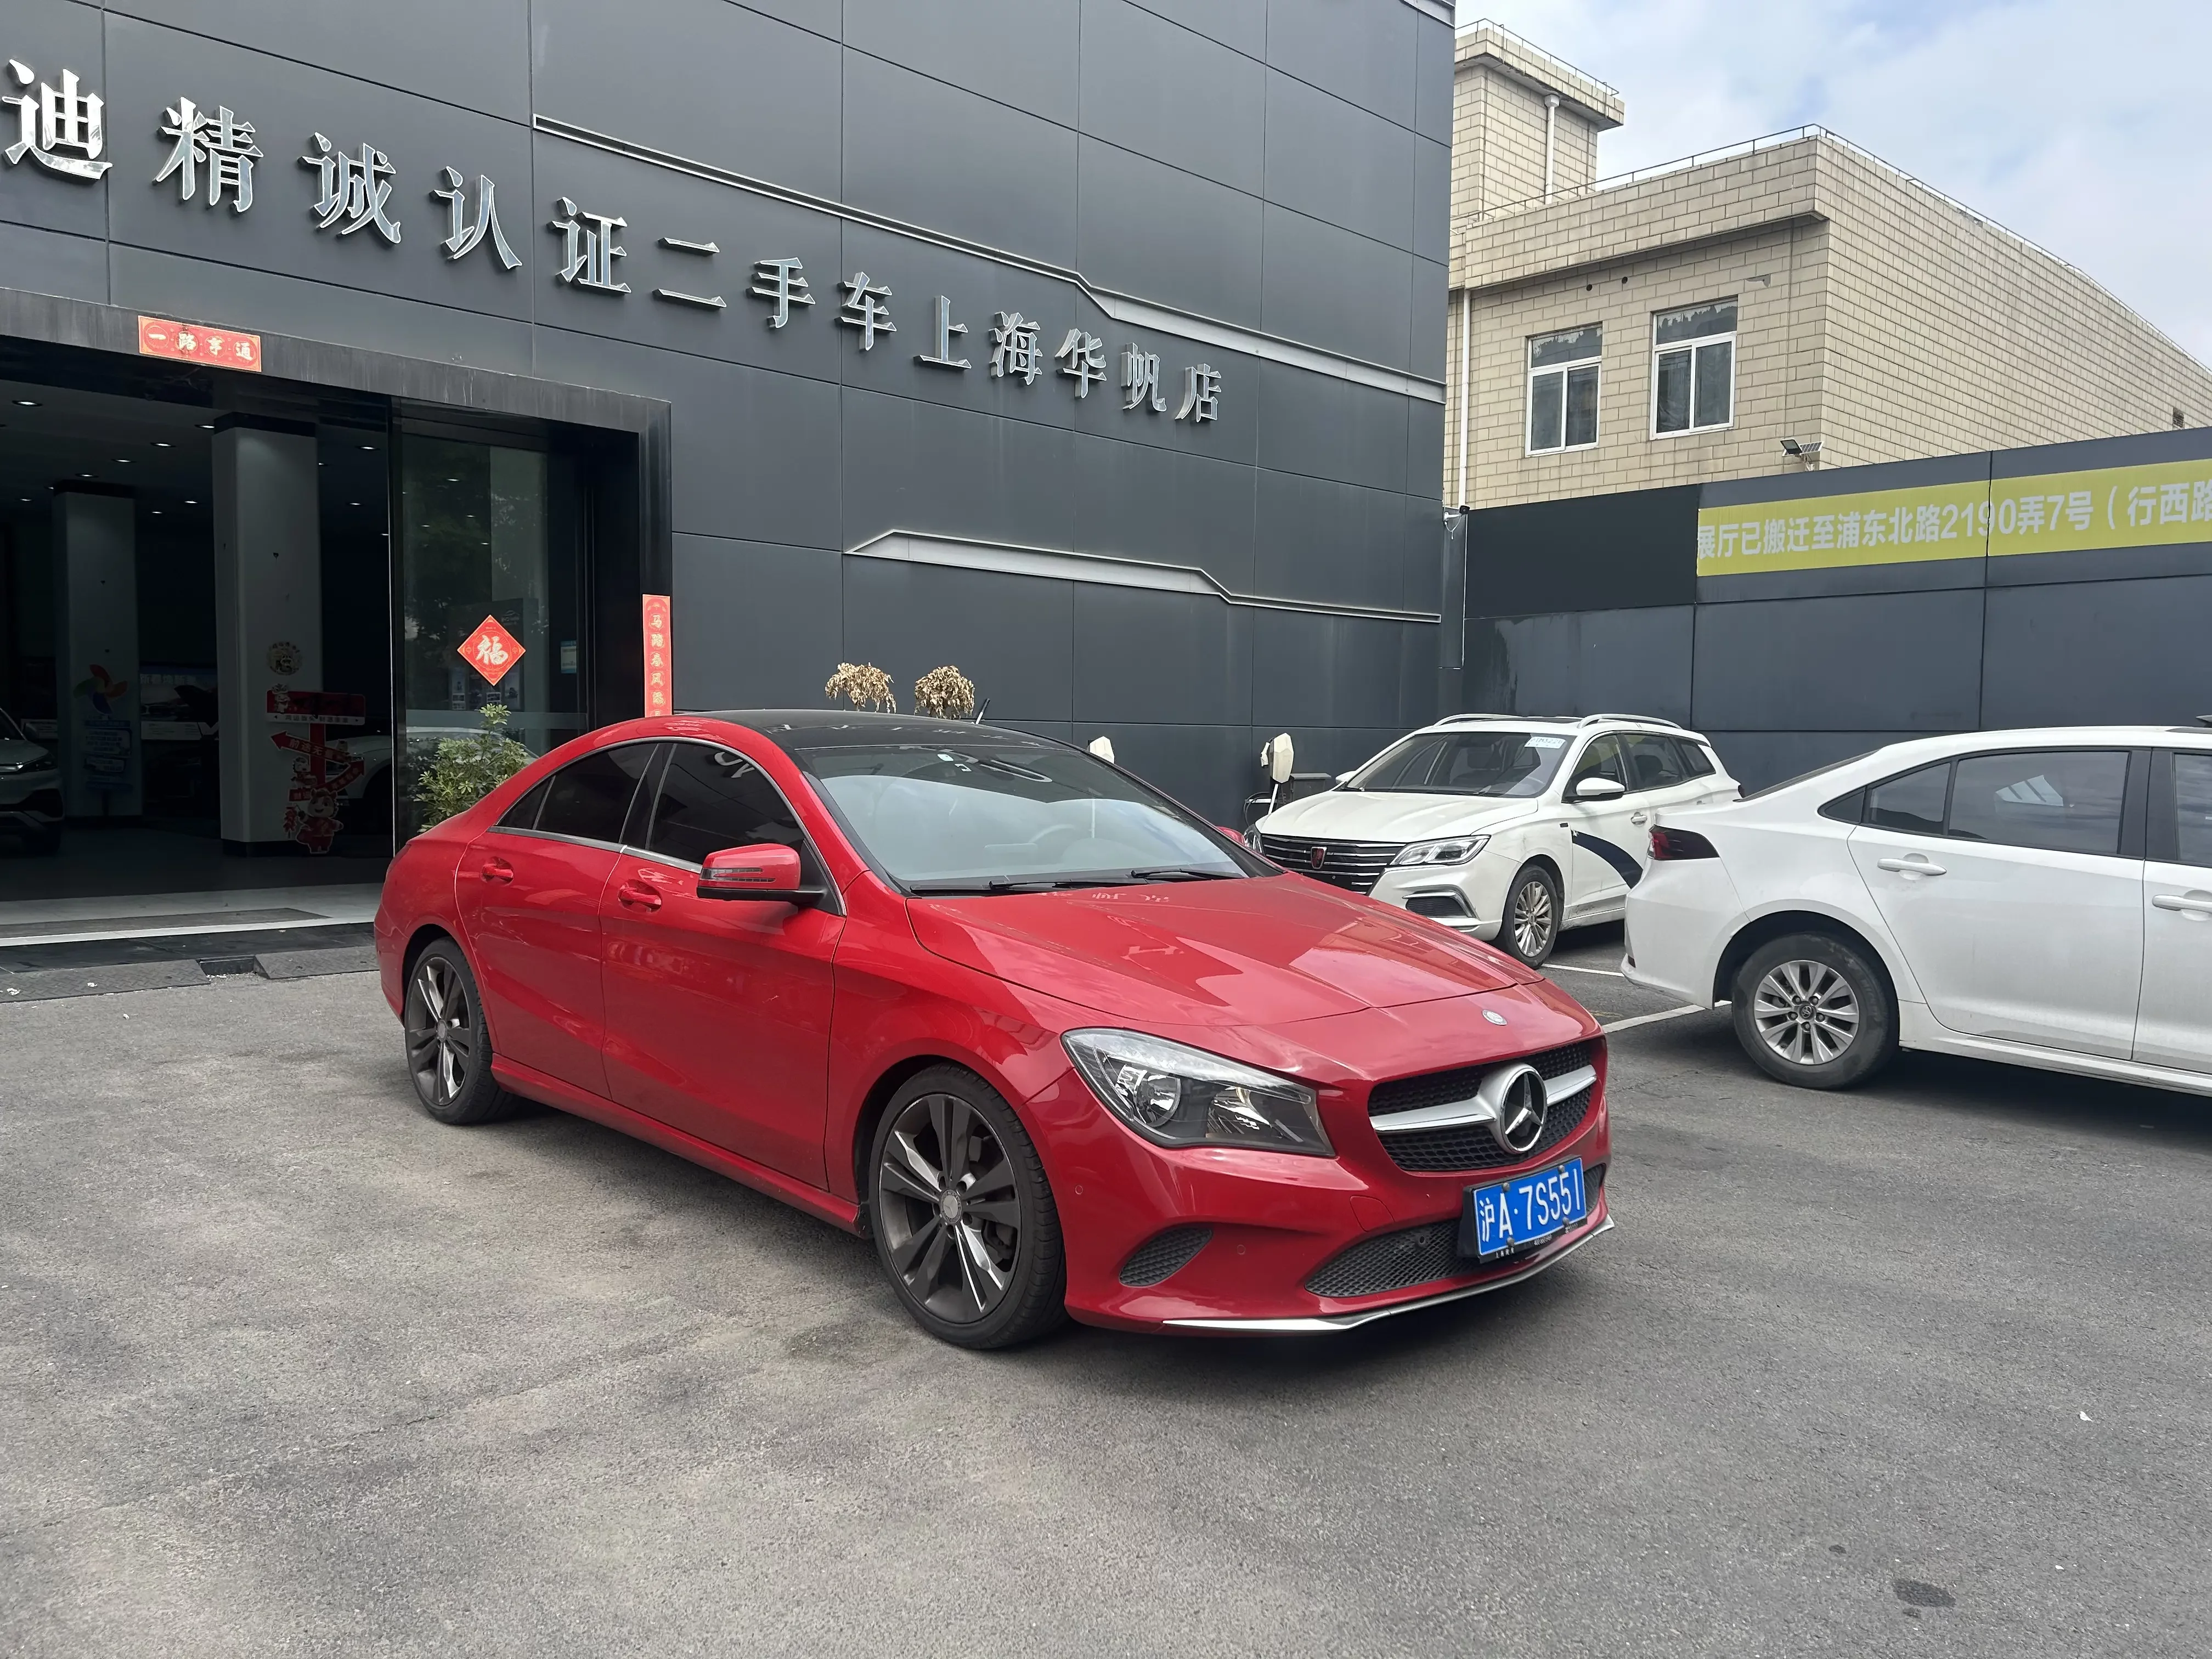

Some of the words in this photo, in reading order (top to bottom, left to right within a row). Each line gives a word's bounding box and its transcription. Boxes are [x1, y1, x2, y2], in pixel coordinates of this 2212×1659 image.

[2, 58, 1222, 423] 迪精诚认证二手车上海华帆店
[148, 331, 253, 360] 一路亨通
[476, 634, 509, 665] 福
[1479, 1168, 1581, 1243] 沪A·7S551
